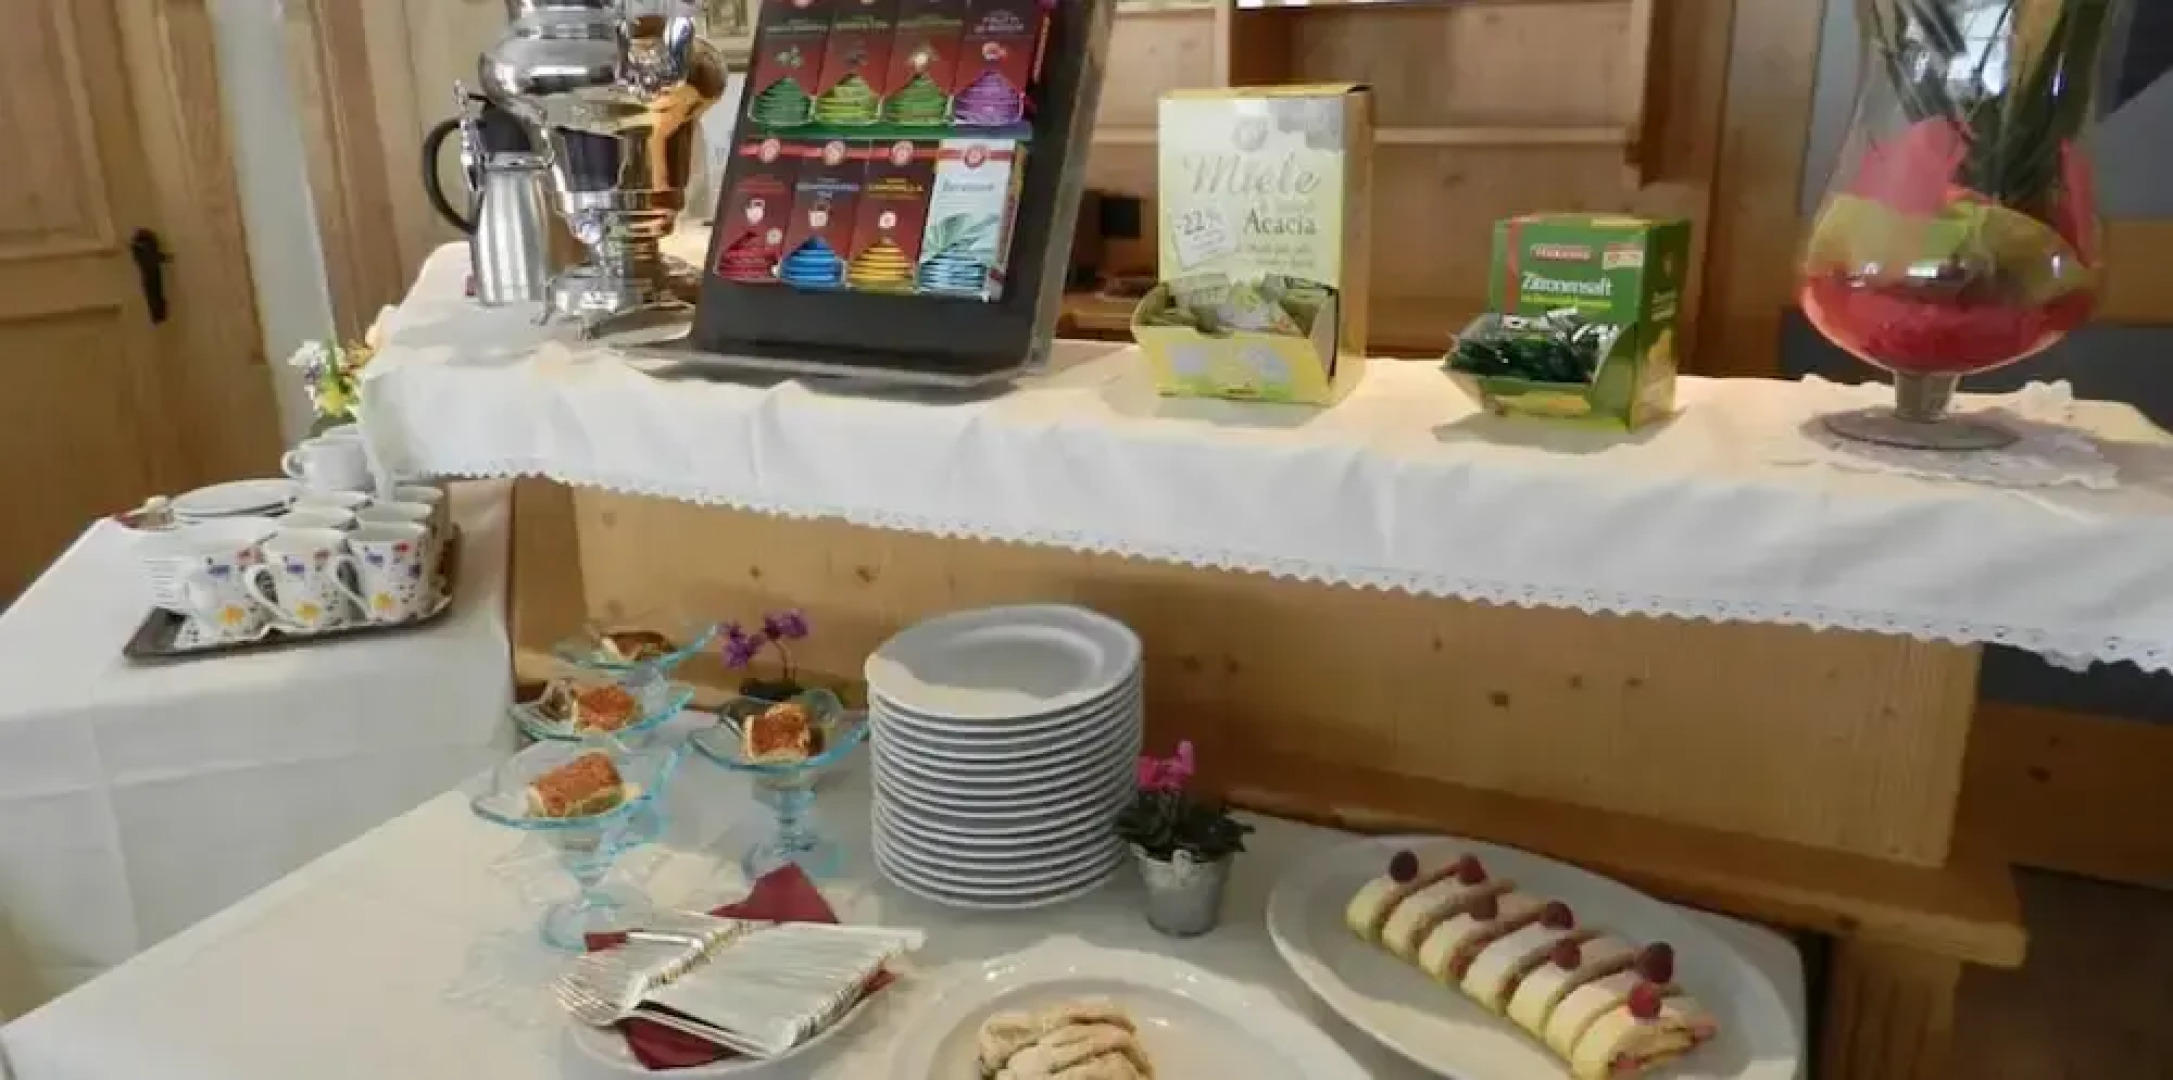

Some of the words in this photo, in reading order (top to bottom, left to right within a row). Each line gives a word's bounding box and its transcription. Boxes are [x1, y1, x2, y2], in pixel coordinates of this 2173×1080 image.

[1183, 151, 1322, 194] Miele
[1242, 207, 1318, 236] Acacia
[1521, 270, 1614, 297] Zitronensaft
